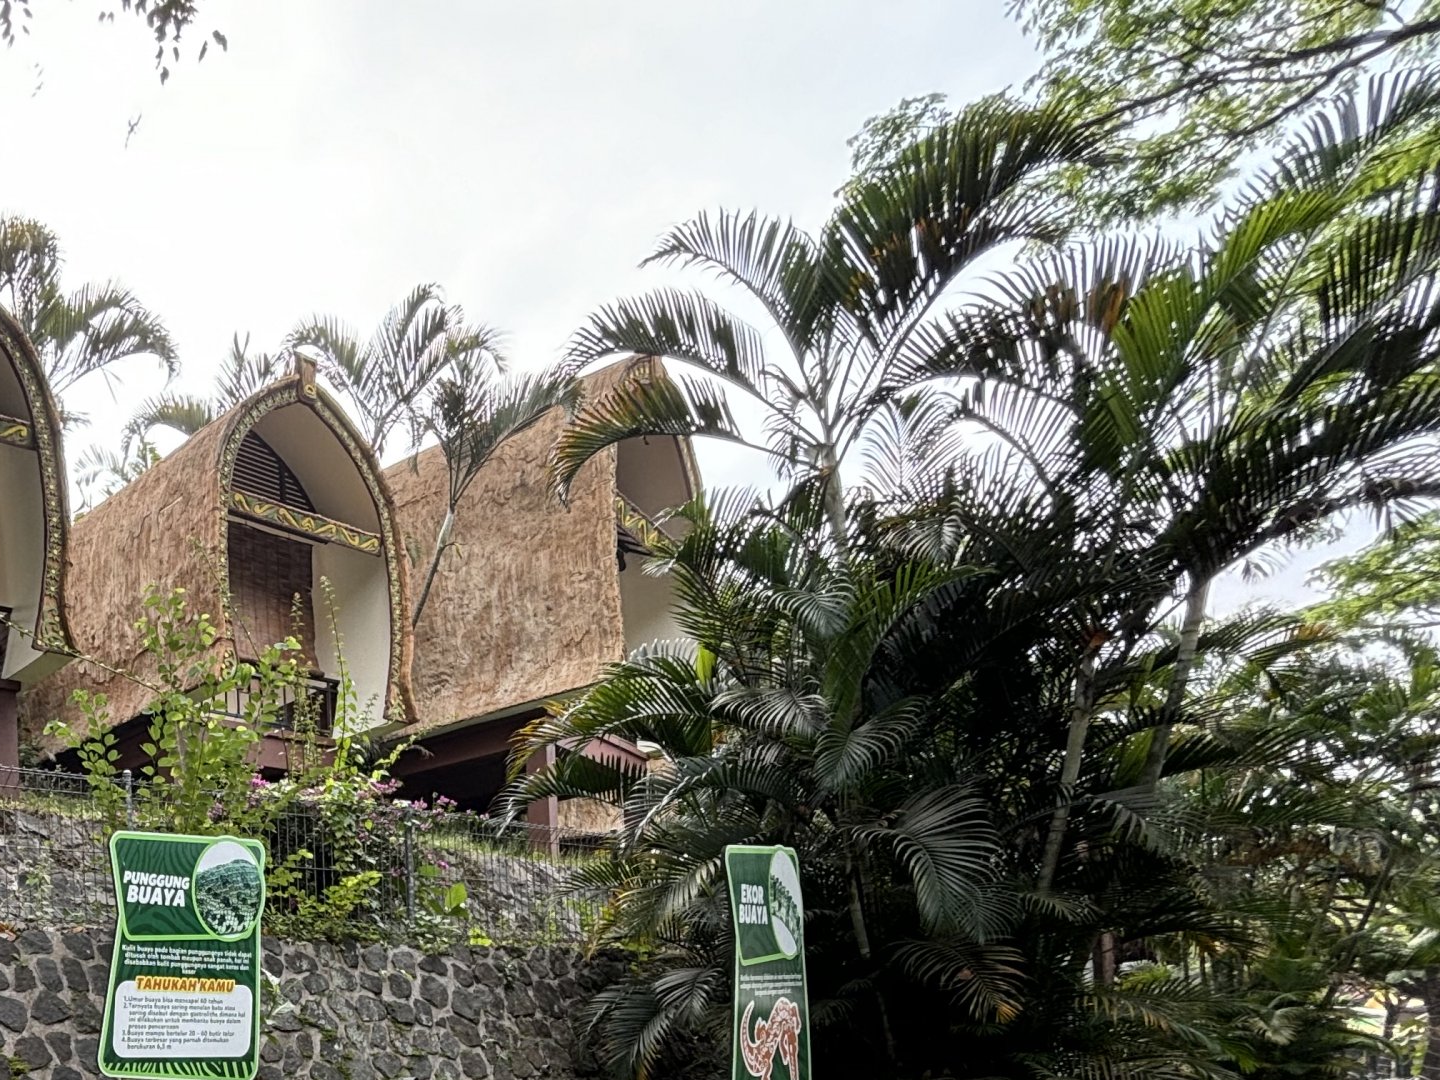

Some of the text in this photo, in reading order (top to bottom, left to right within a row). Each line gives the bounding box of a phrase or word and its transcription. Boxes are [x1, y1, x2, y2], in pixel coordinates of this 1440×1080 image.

[123, 870, 190, 889] PUNGGUNG
[127, 885, 186, 907] BUAYA
[741, 884, 764, 904] EKOR
[739, 903, 768, 925] BUAYA
[137, 978, 234, 993] TAHUKAH KAMU
